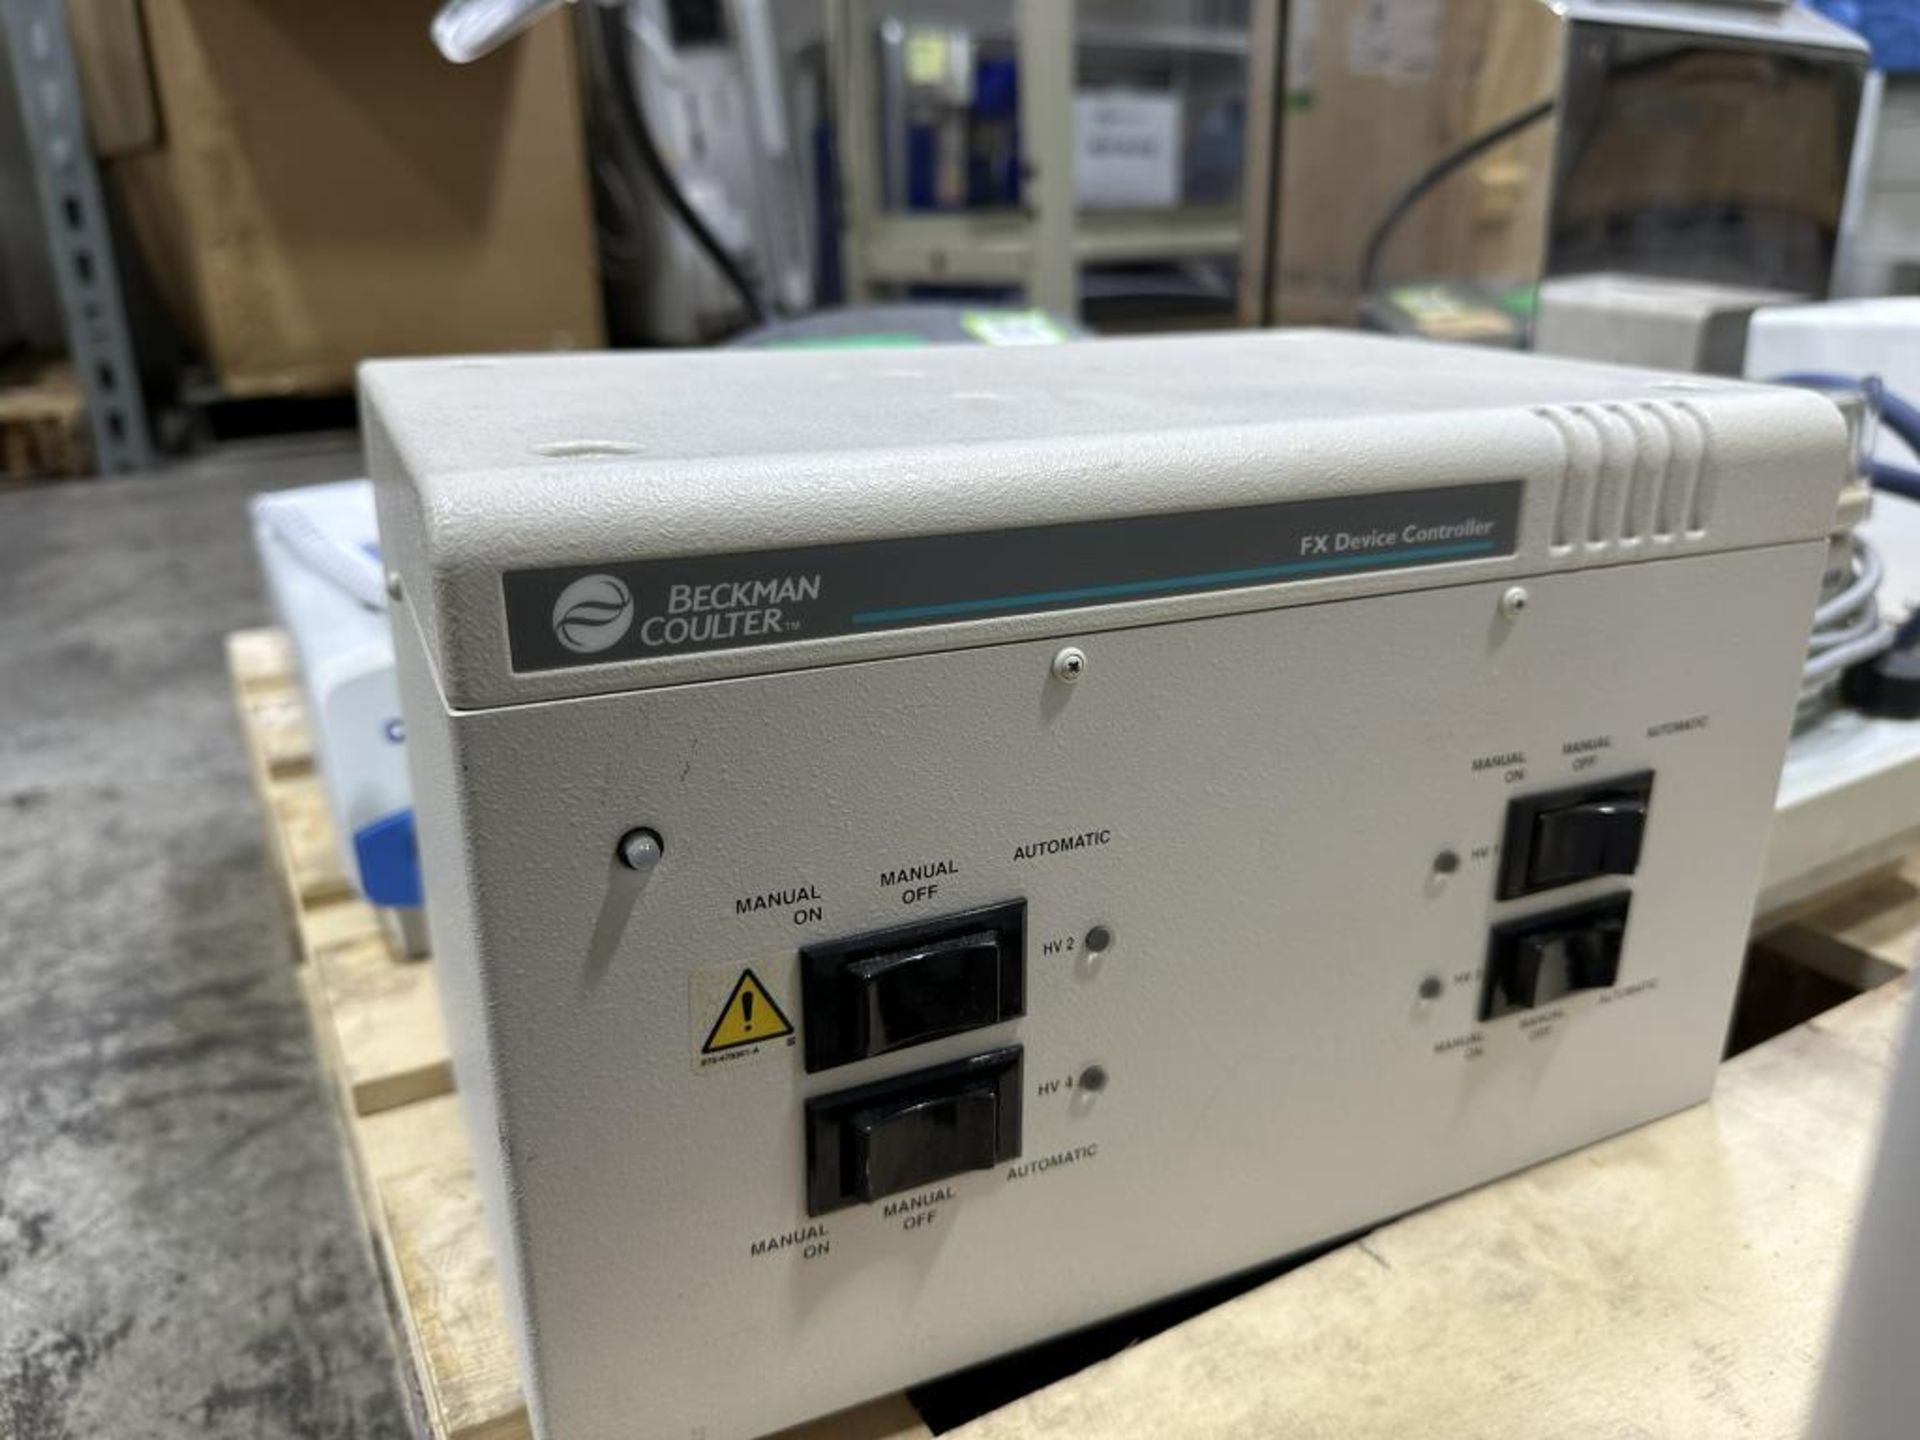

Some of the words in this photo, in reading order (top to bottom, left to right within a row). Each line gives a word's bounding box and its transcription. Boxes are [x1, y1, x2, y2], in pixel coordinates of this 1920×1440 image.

[1300, 534, 1330, 555] FX
[1333, 530, 1397, 552] Device
[1402, 517, 1495, 544] Controller
[667, 574, 822, 615] BECKMAN
[640, 608, 785, 646] COULTER
[1645, 715, 1710, 739] AUTOMATIC
[1561, 735, 1613, 755] MANUAL
[1471, 751, 1528, 772] MANUAL
[1572, 754, 1598, 772] OFF
[1504, 768, 1525, 784] ON
[1012, 829, 1112, 862] AUTOMATIC
[880, 859, 959, 888] MANUAL
[735, 884, 822, 915] MANUAL
[902, 884, 939, 905] OFF
[793, 906, 824, 927] ON
[1042, 940, 1065, 957] HV
[1065, 937, 1075, 952] 2
[1037, 1079, 1060, 1097] HV
[1064, 1076, 1074, 1091] 4
[1005, 1142, 1099, 1182] AUTOMATIC
[883, 1185, 957, 1220] MANUAL
[902, 1210, 938, 1231] OFF
[750, 1224, 830, 1258] MANUAL
[802, 1239, 831, 1260] ON
